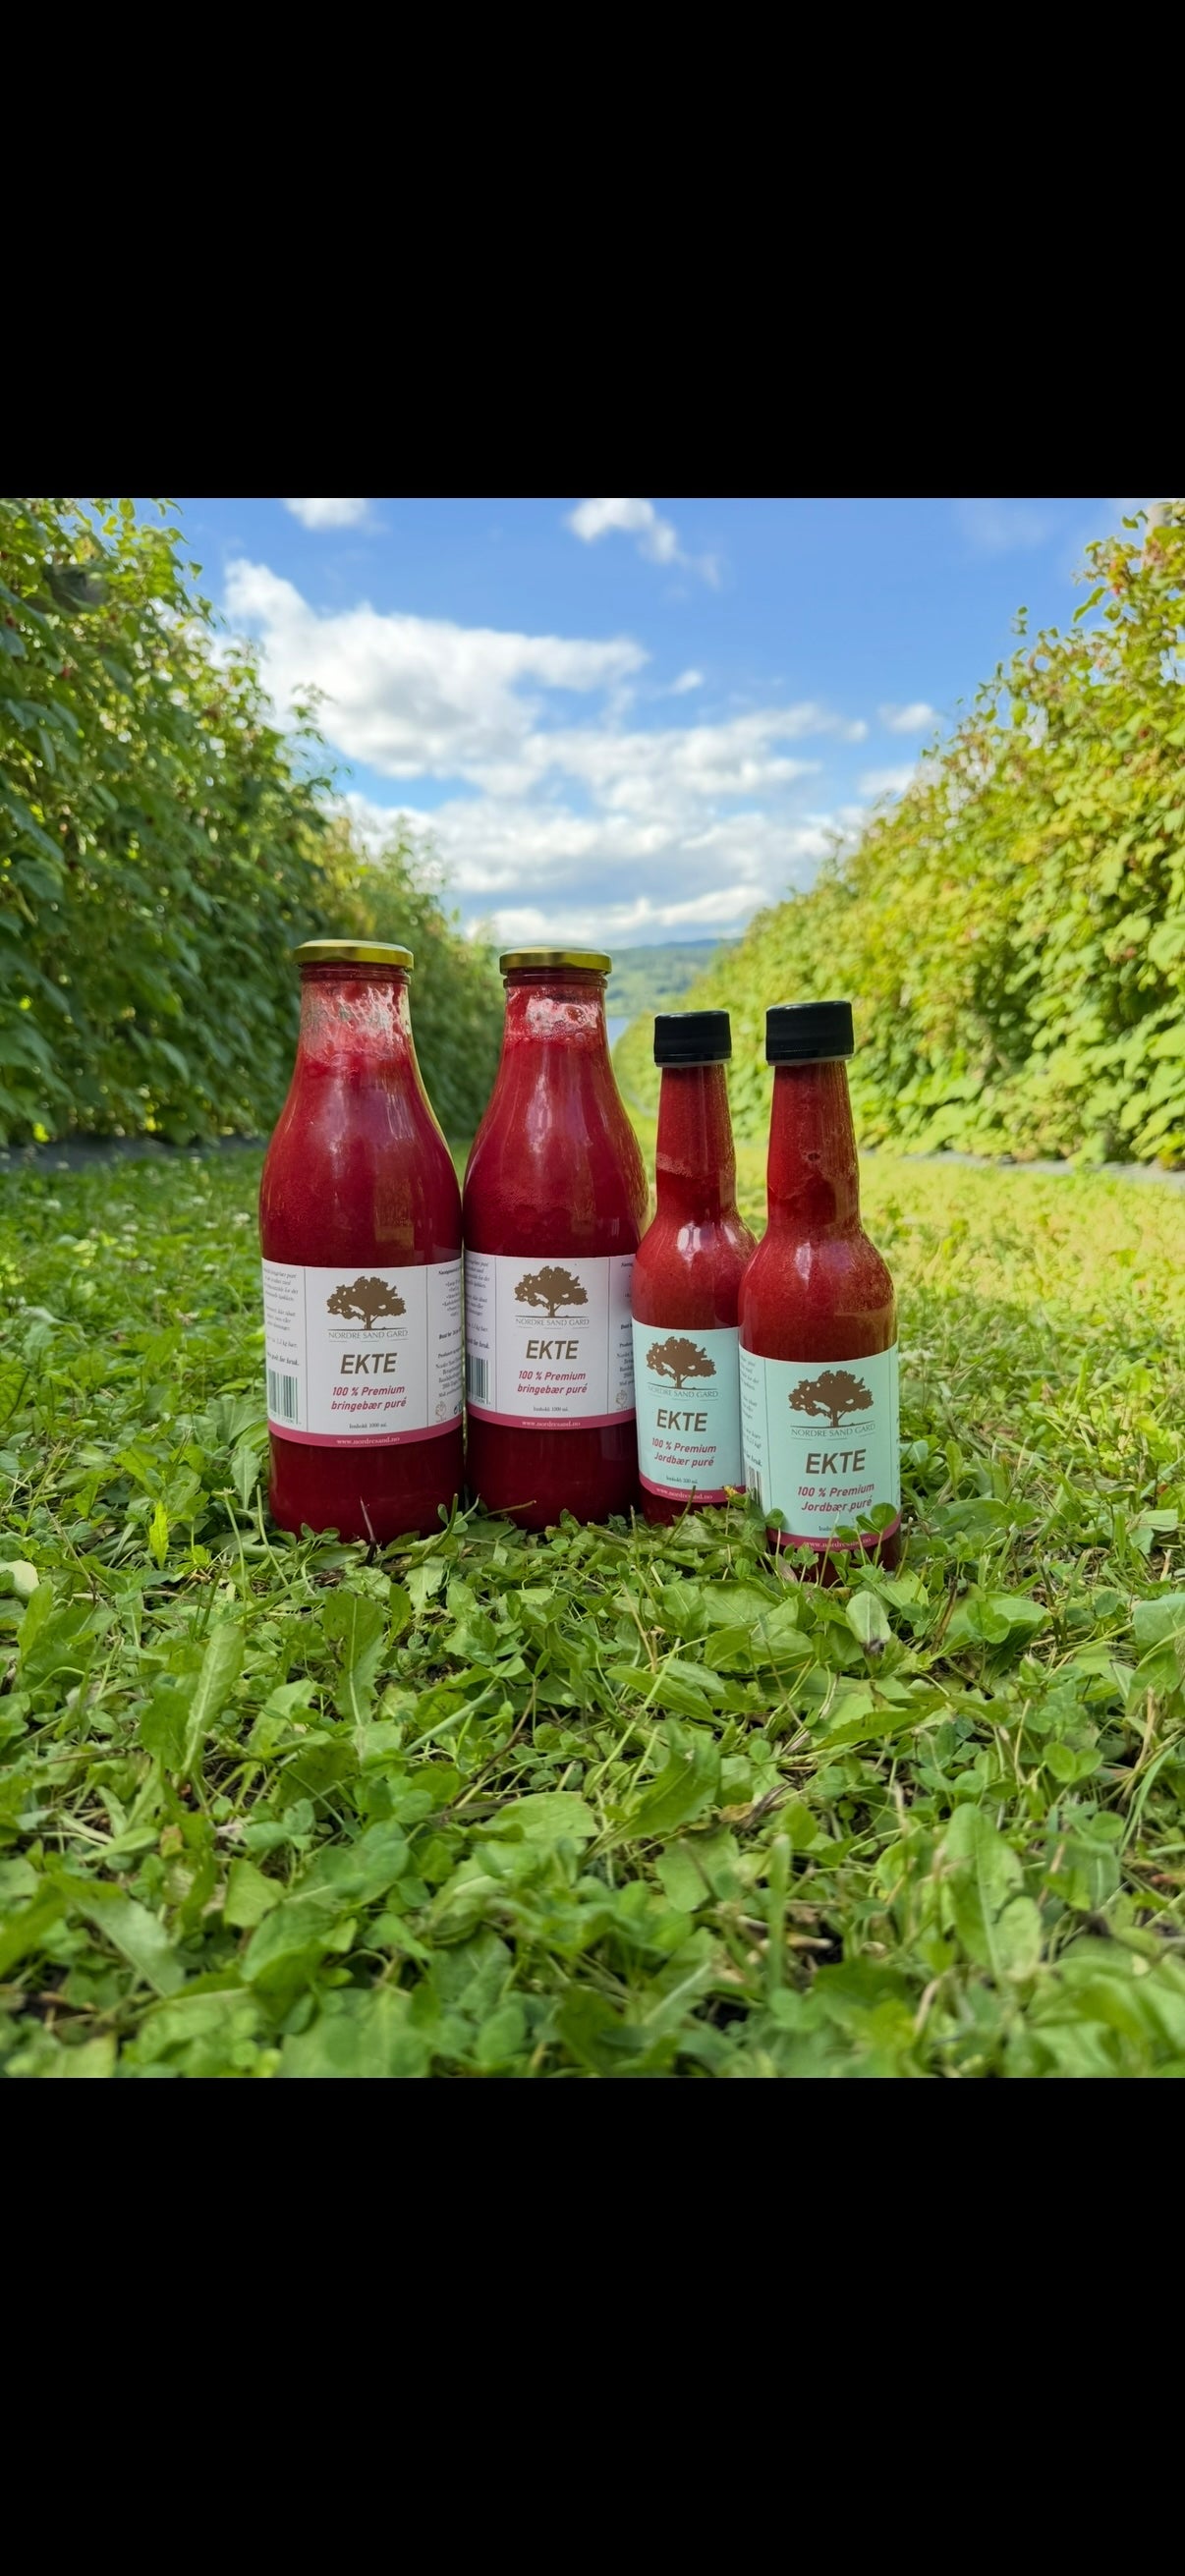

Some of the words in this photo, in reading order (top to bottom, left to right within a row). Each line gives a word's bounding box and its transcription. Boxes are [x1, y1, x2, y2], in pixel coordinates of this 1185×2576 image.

[526, 1340, 580, 1360] EKTE
[340, 1352, 398, 1374] EKTE
[518, 1370, 534, 1380] 100
[535, 1371, 543, 1380] %
[543, 1372, 587, 1381] Premium
[332, 1386, 349, 1396] 100
[350, 1386, 360, 1396] %
[361, 1384, 405, 1396] Premium
[517, 1383, 565, 1395] bringebær
[565, 1382, 589, 1396] puré
[674, 1389, 695, 1398] SAND
[331, 1400, 382, 1412] bringebær
[383, 1396, 408, 1411] puré
[656, 1408, 708, 1432] EKTE
[791, 1428, 827, 1437] NORDRE
[828, 1428, 853, 1436] SAND
[651, 1437, 664, 1448] 100
[665, 1441, 672, 1450] %
[673, 1442, 717, 1453] Premium
[654, 1452, 690, 1466] Jordbær
[691, 1456, 715, 1468] puré
[805, 1448, 867, 1475] EKTE
[798, 1485, 816, 1497] 100
[818, 1487, 827, 1497] %
[828, 1484, 875, 1497] Premium
[801, 1501, 848, 1512] Jordbær
[849, 1495, 873, 1513] puré
